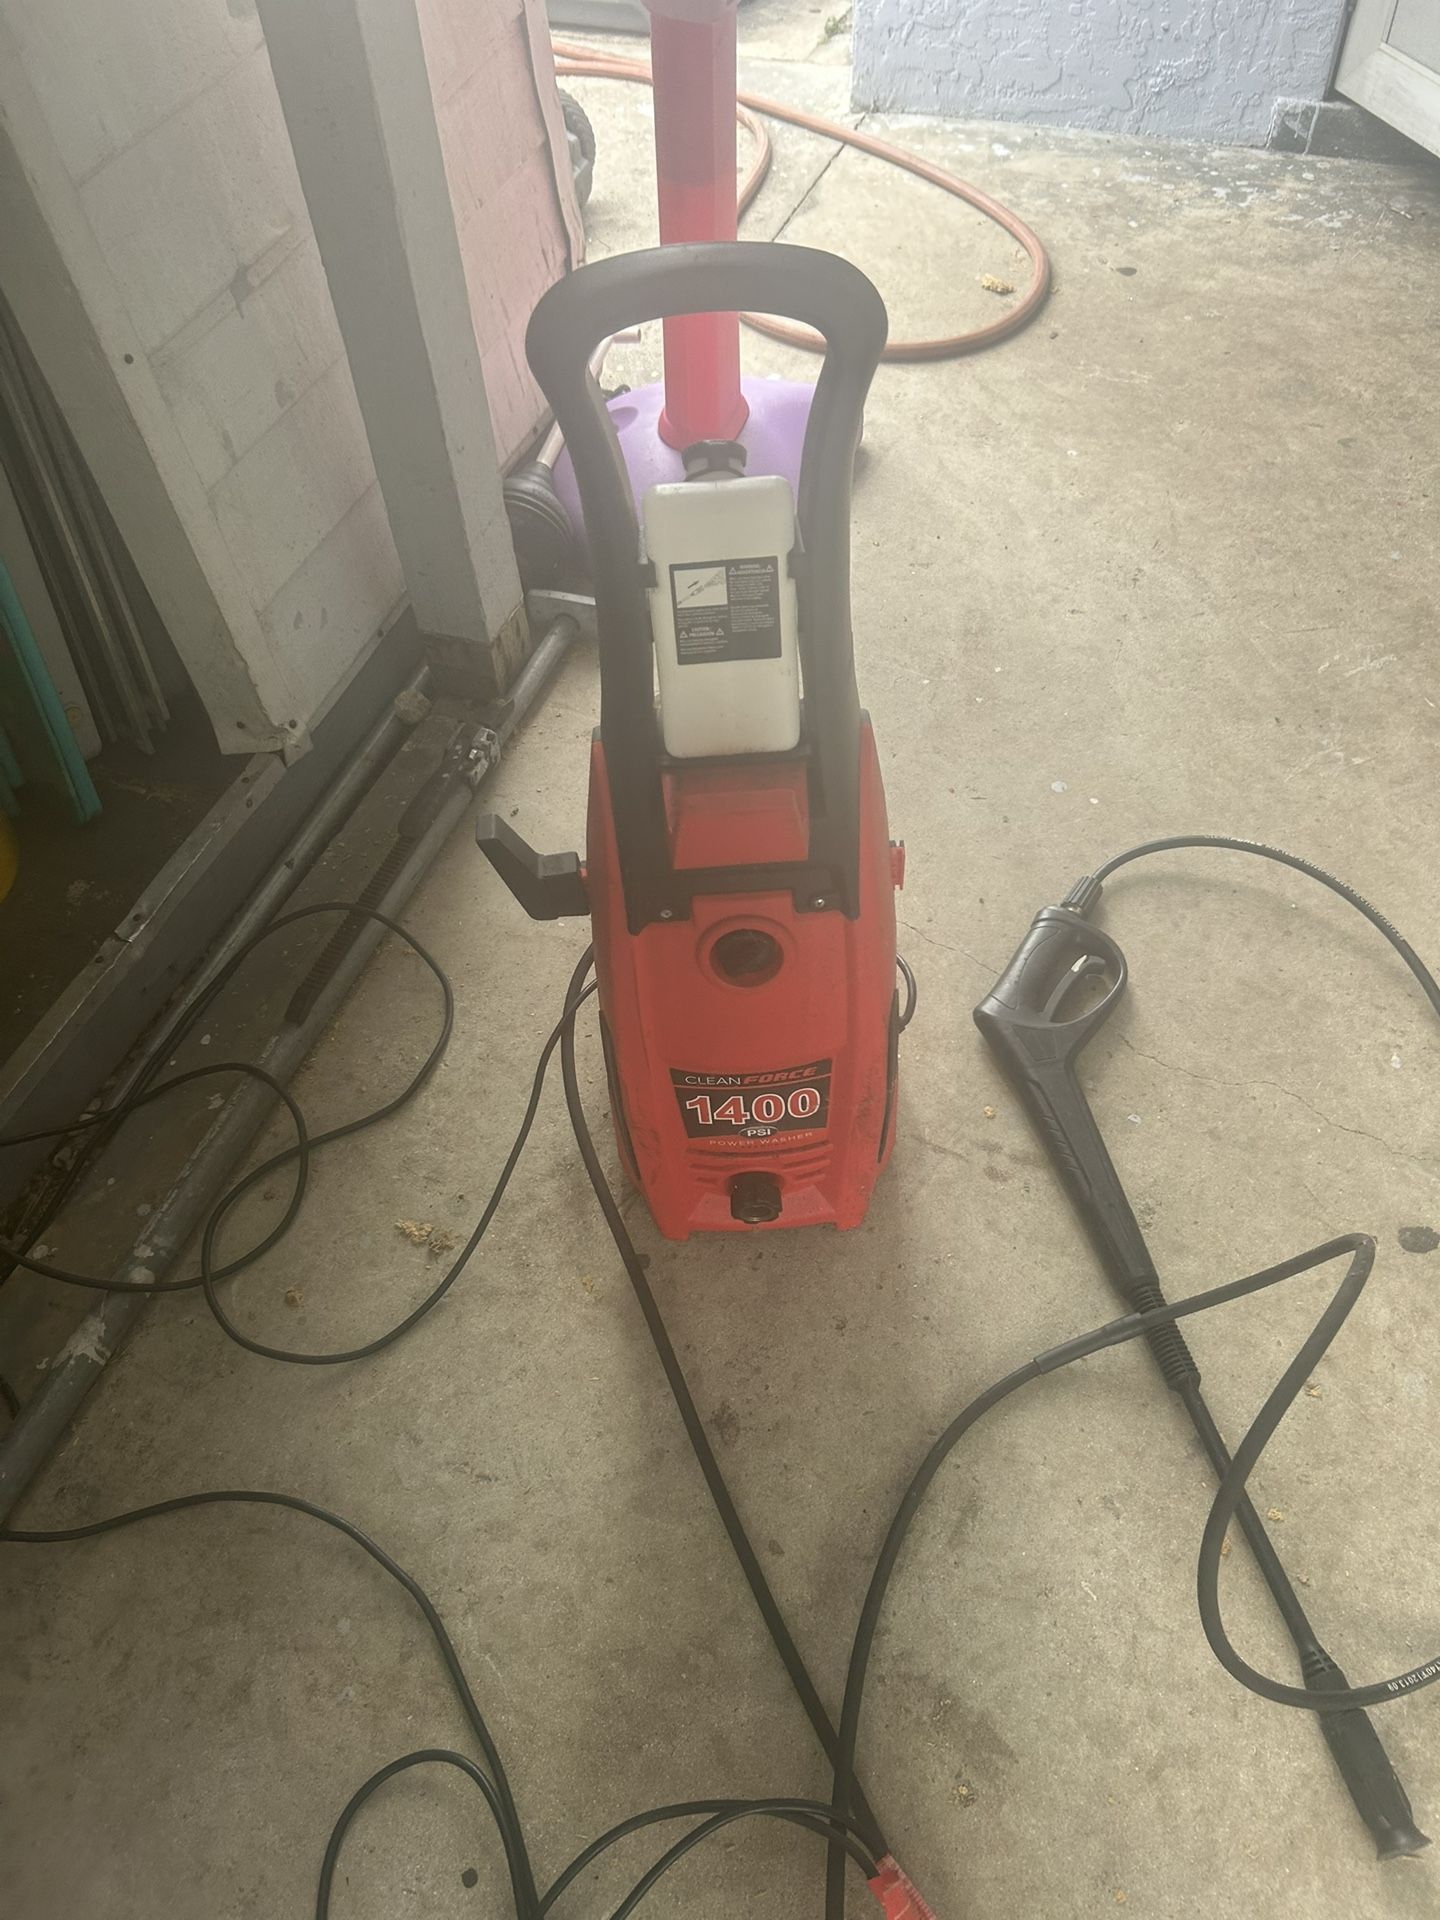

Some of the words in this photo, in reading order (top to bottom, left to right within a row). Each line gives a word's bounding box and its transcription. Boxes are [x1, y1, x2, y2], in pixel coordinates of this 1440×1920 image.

[686, 1088, 820, 1125] 1400
[747, 1128, 771, 1137] PSI
[760, 1132, 813, 1145] WASHER
